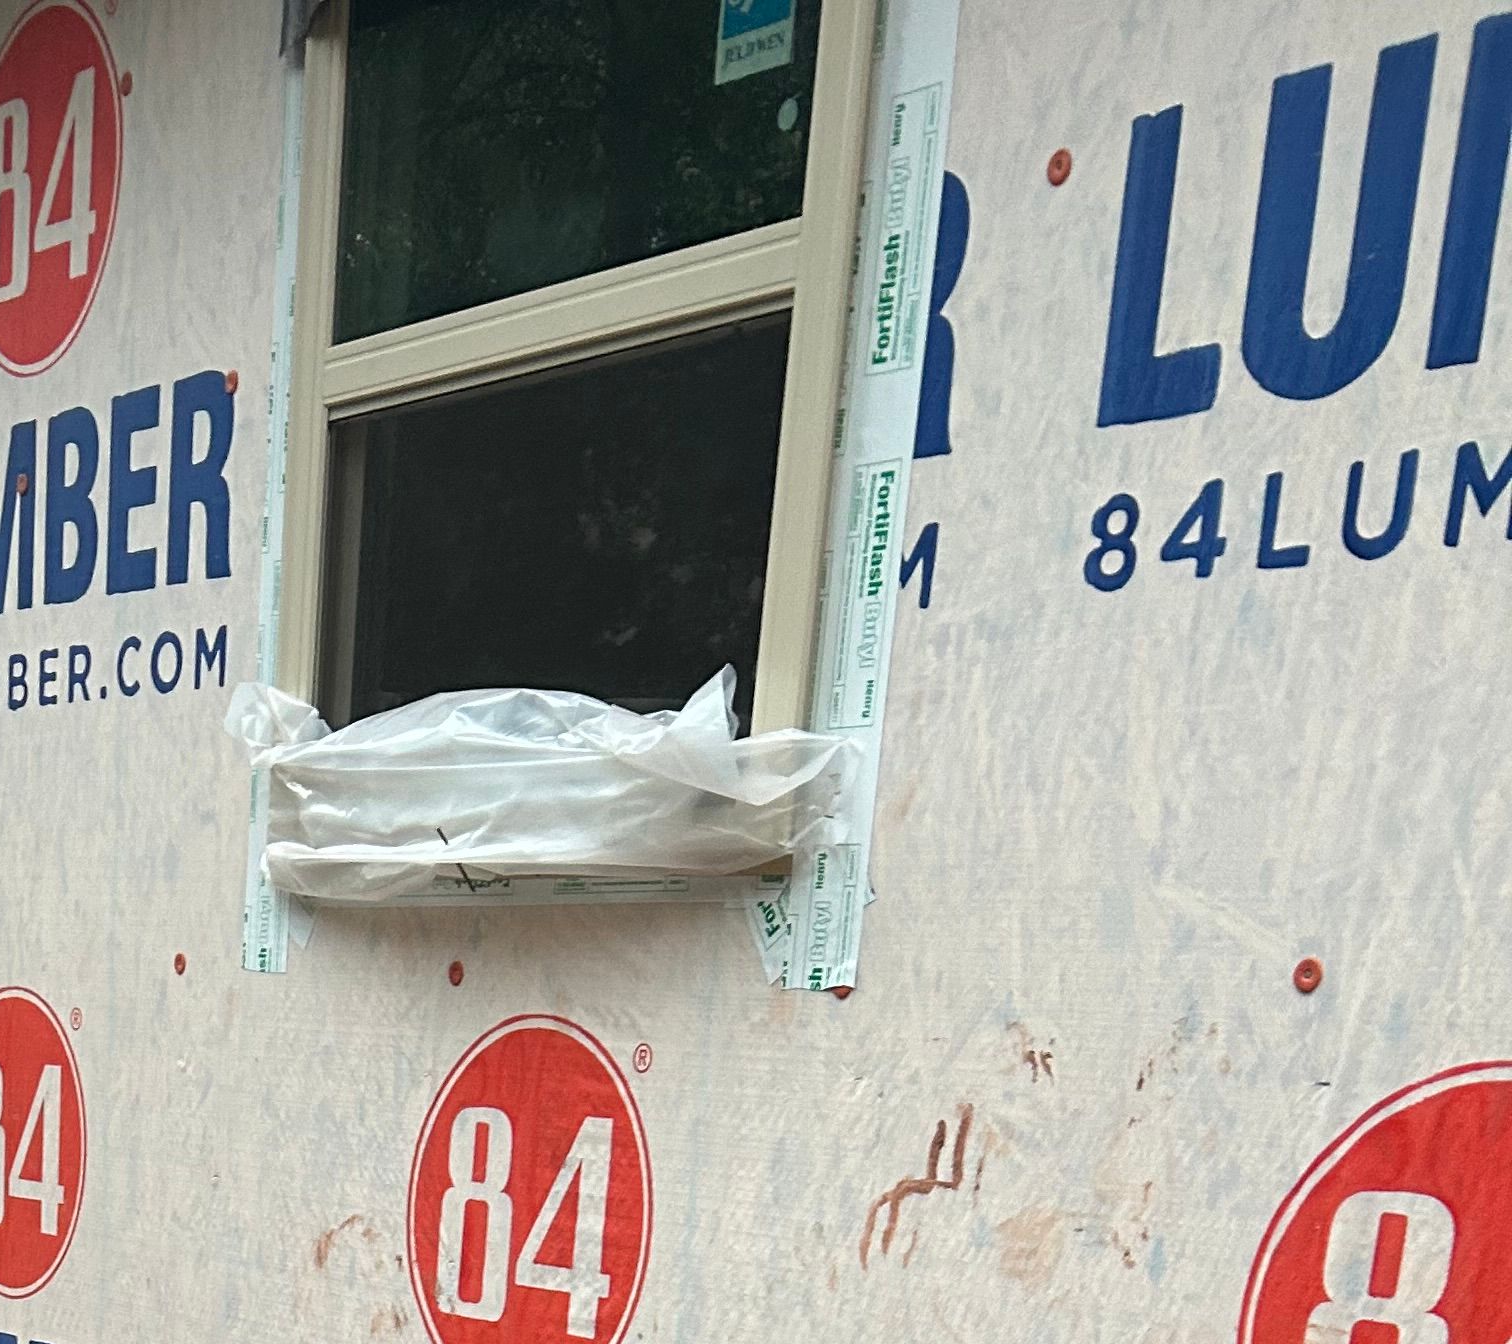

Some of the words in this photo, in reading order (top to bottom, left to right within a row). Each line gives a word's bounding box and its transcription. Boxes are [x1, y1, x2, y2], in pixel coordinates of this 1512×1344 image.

[871, 231, 902, 366] FortiFlash
[867, 469, 895, 597] FortiFlash
[437, 1105, 614, 1340] 84
